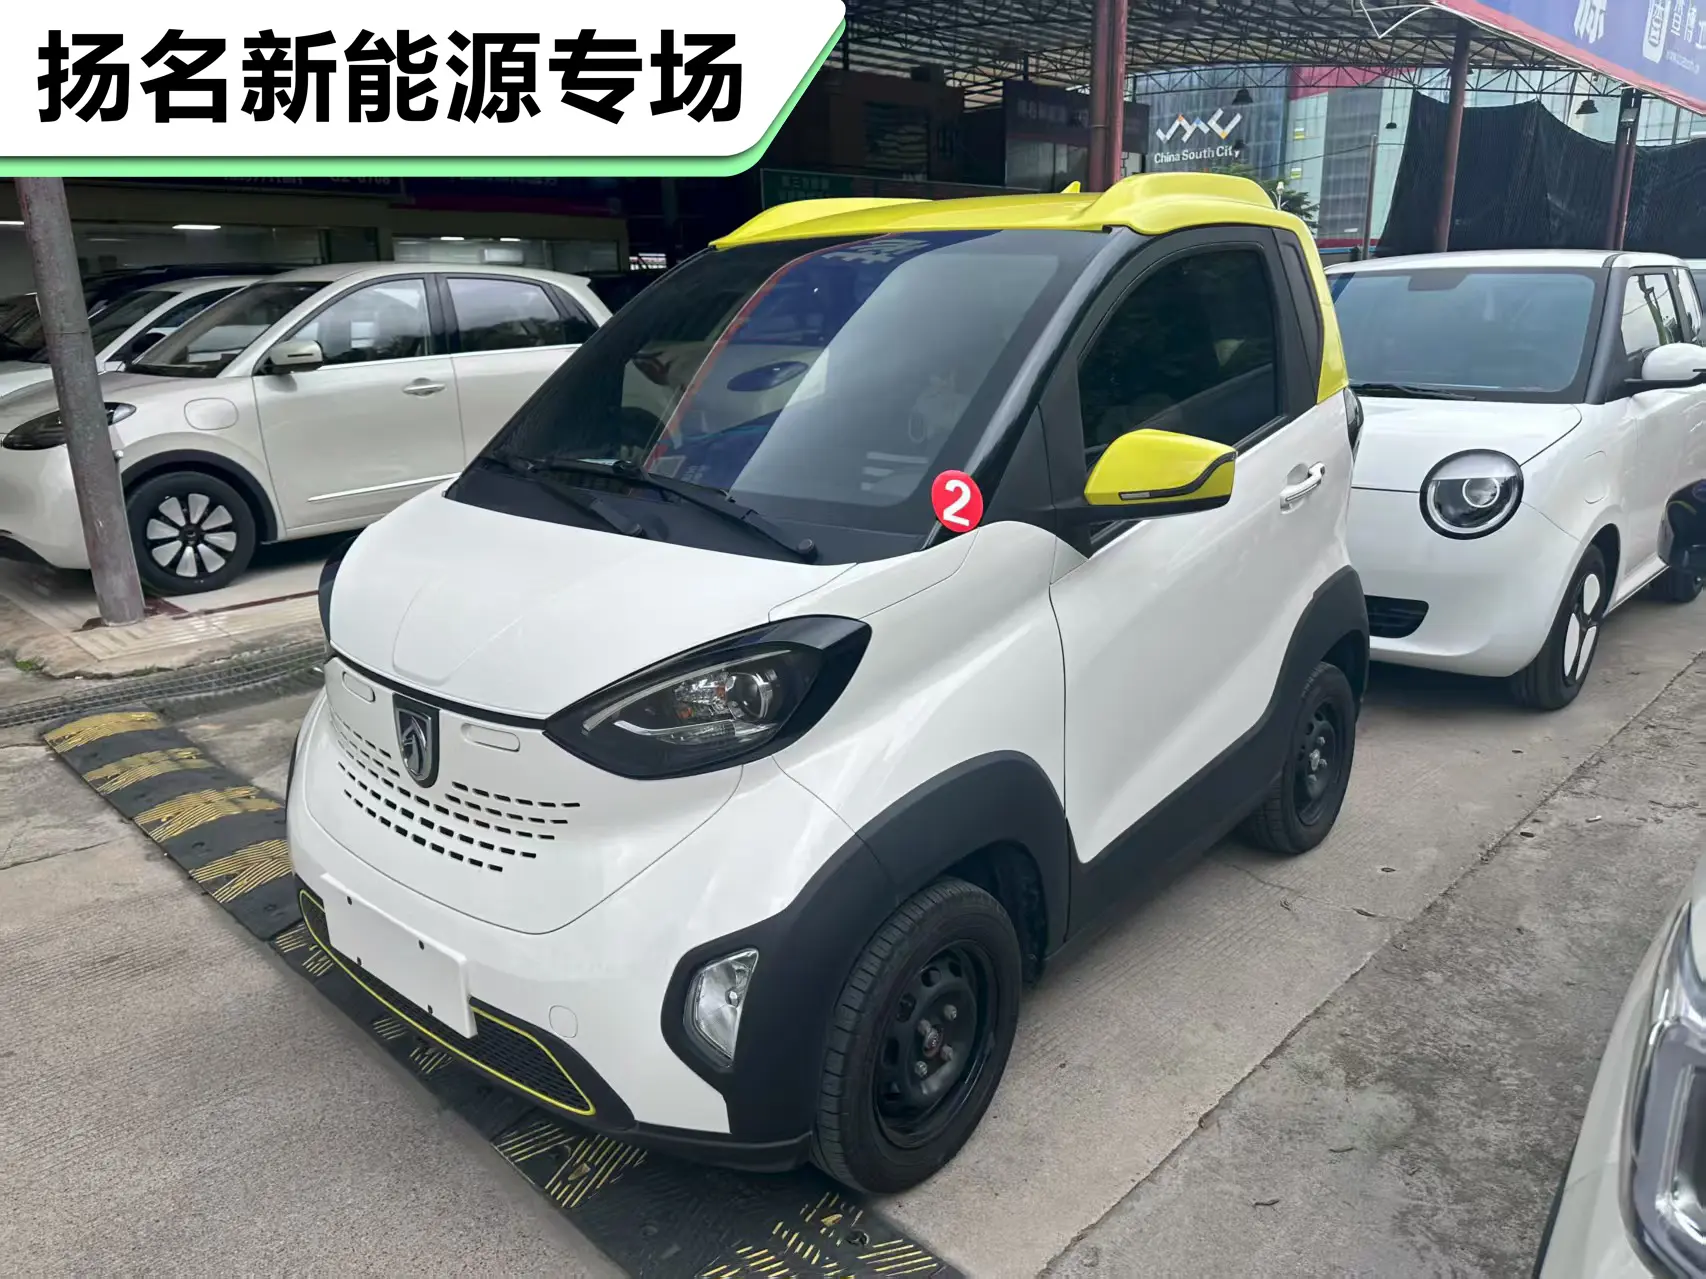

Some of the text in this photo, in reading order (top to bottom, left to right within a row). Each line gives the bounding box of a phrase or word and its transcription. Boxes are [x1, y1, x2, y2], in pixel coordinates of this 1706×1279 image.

[1154, 145, 1240, 164] China South City
[943, 479, 971, 526] 2
